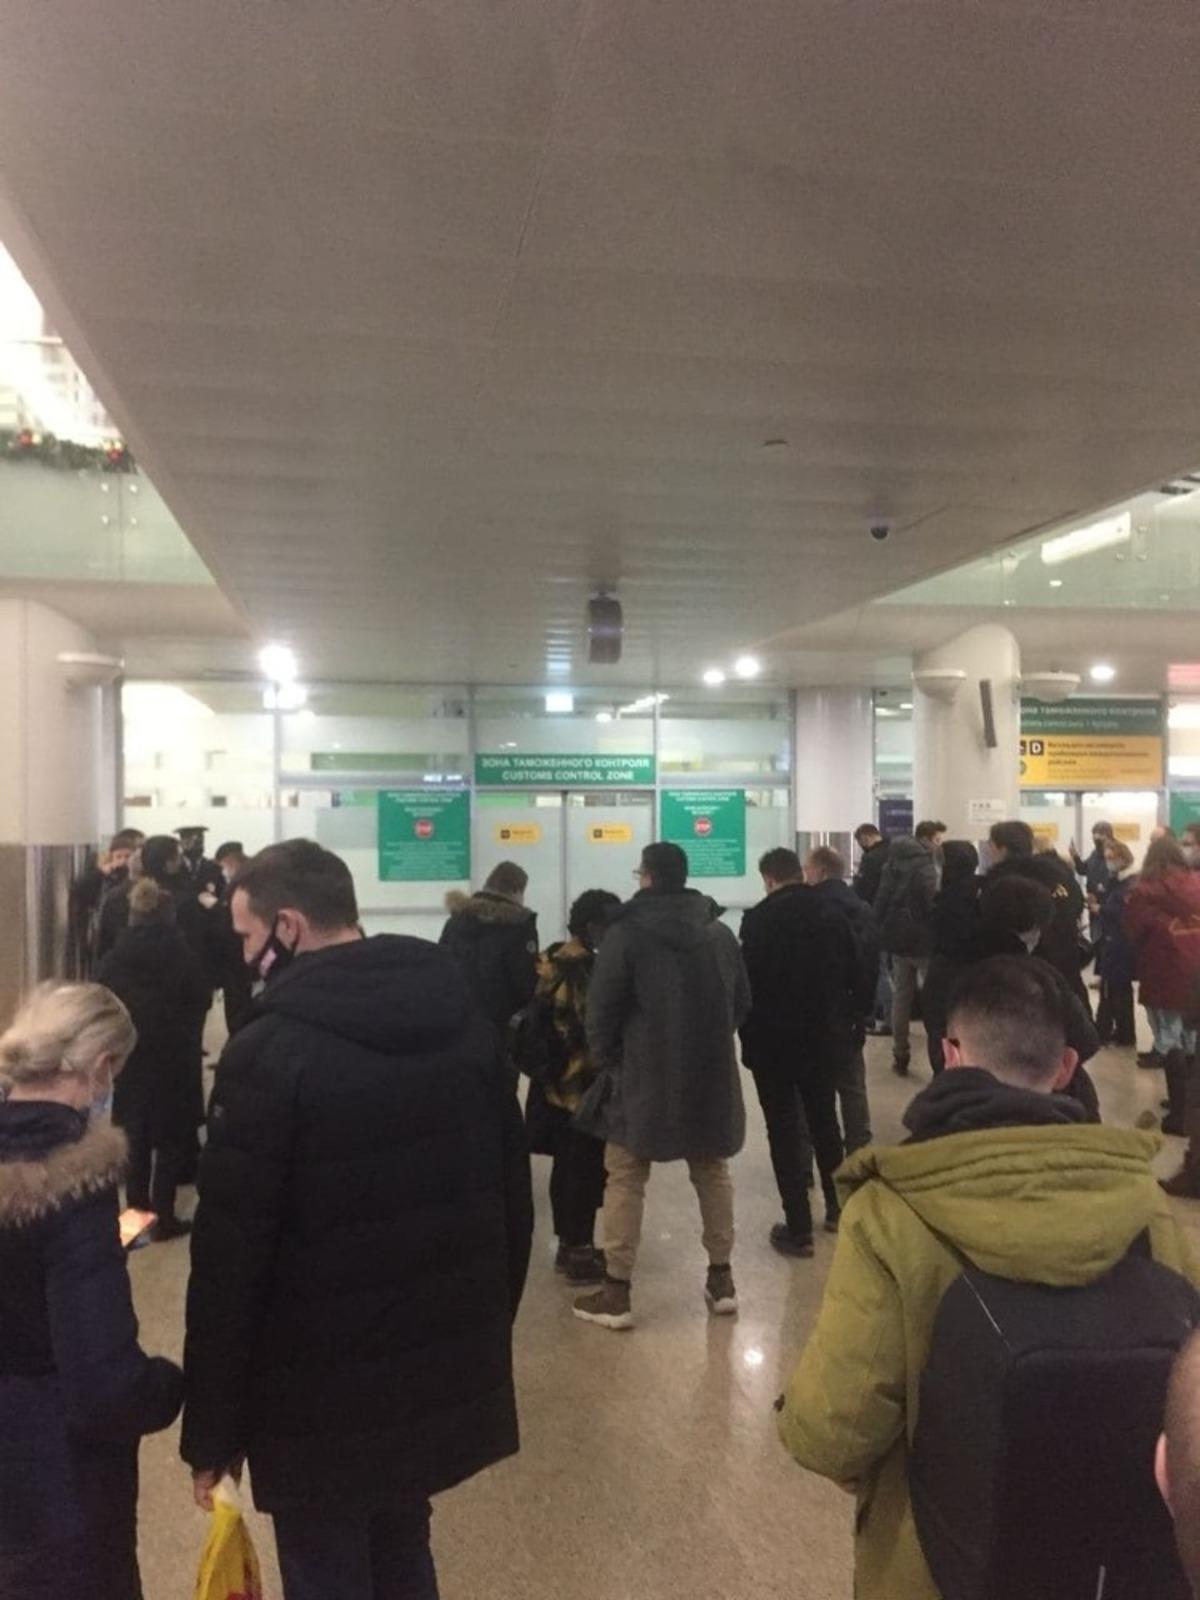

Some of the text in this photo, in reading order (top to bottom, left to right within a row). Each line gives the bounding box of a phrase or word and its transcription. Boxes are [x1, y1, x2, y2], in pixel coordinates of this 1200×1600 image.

[481, 757, 650, 769] ЗОНА ТАМОЖЕННОГО КОНТРОЛЯ
[501, 770, 635, 781] CUSTOMS CONTROL ZONE
